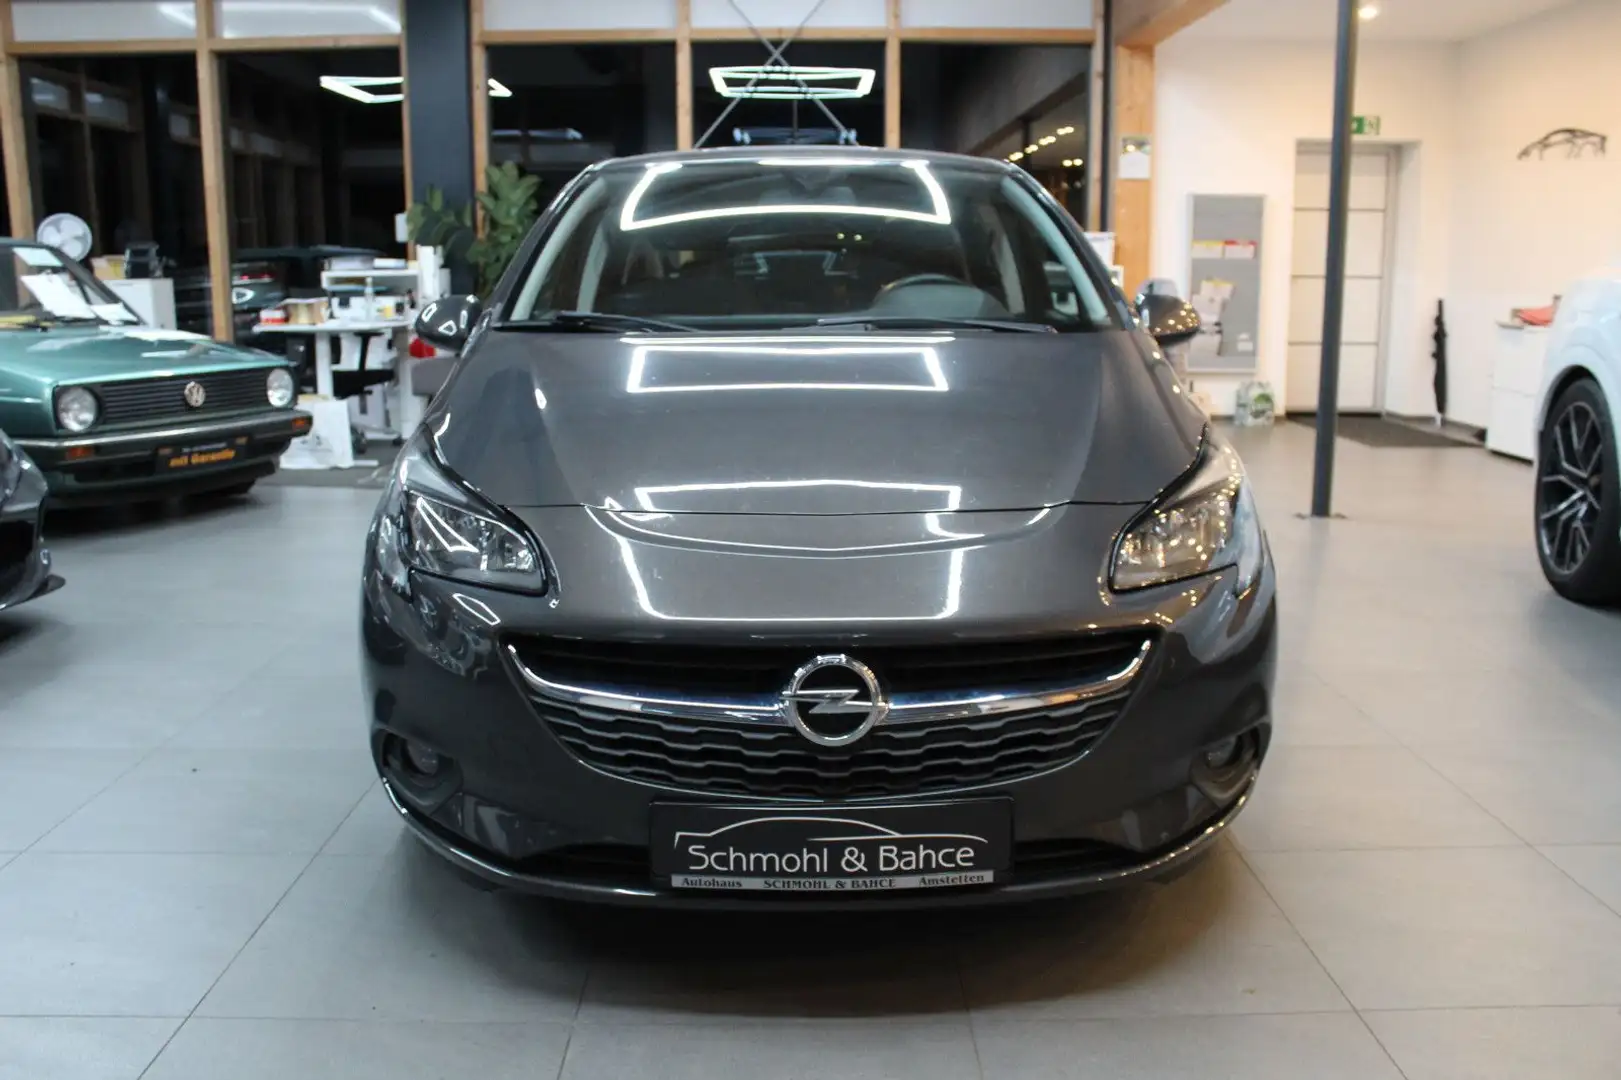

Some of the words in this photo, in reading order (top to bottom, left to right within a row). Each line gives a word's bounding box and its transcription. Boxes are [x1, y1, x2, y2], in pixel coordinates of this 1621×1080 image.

[688, 845, 828, 873] Schmohl
[841, 847, 868, 873] &
[879, 844, 975, 871] Bahce
[681, 877, 743, 889] Autohaus
[763, 879, 832, 890] SCHMOHL
[835, 880, 847, 889] &
[851, 878, 897, 890] BAHCE
[918, 874, 985, 888] Amstetten
